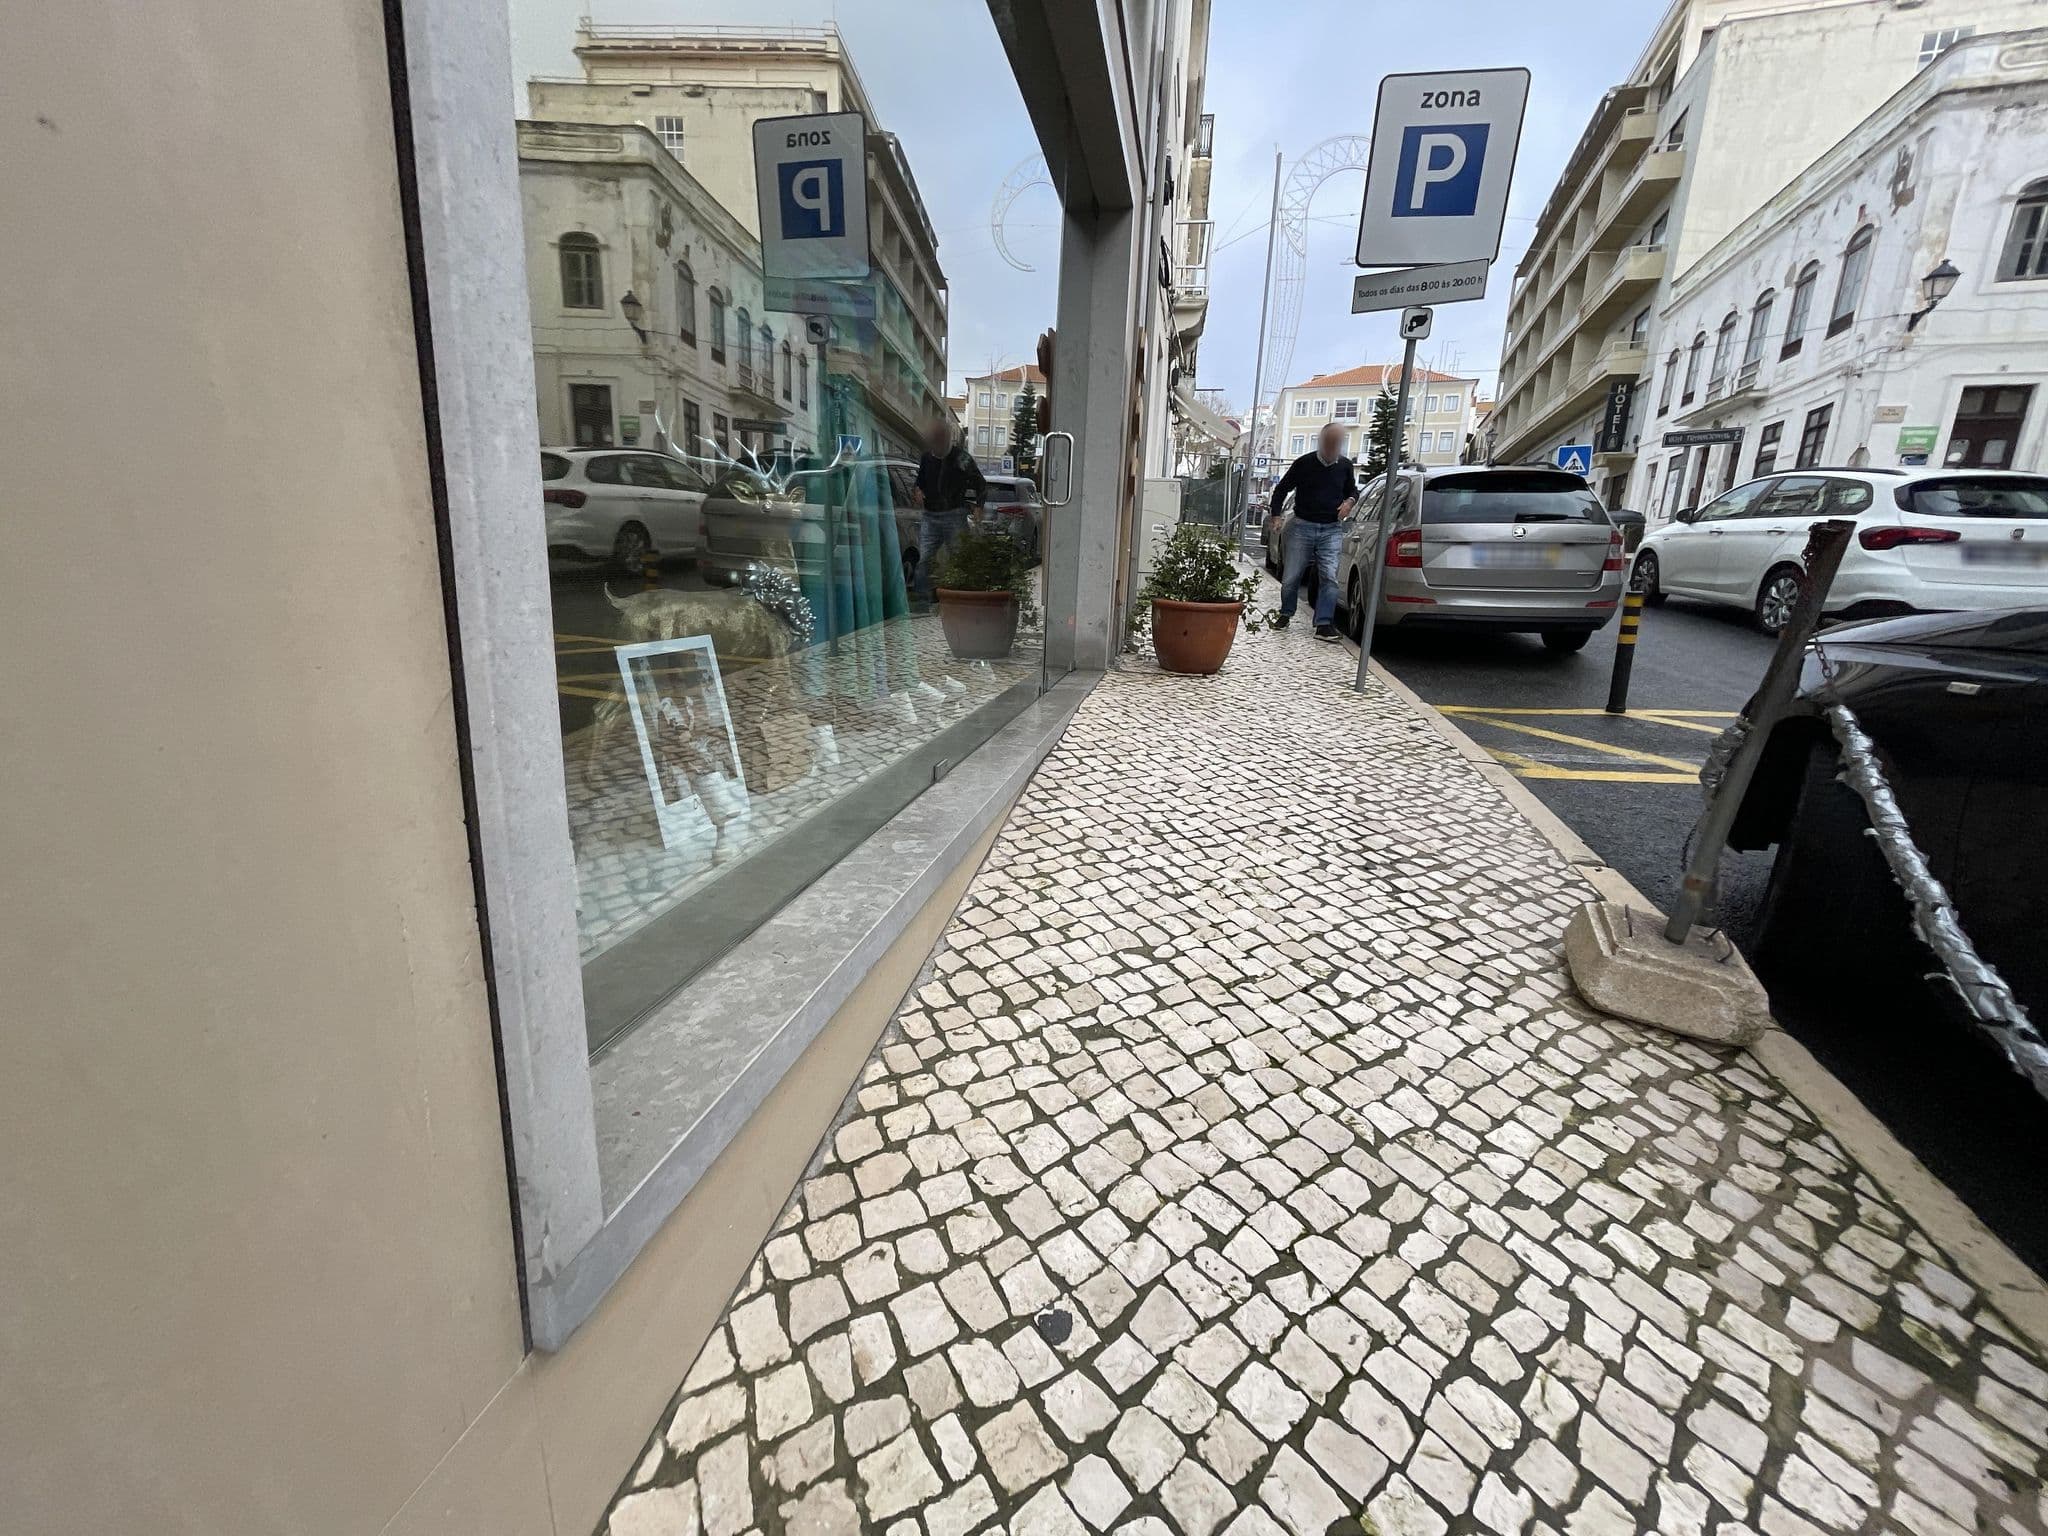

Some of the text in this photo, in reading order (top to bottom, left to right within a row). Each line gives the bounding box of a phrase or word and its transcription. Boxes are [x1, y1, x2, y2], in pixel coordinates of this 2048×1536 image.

[1420, 89, 1481, 109] zona
[1410, 133, 1467, 210] P
[1358, 289, 1378, 299] Todos
[1379, 288, 1388, 296] os
[1390, 285, 1404, 295] dias
[1407, 284, 1420, 292] das
[1611, 384, 1628, 434] HOTEL
